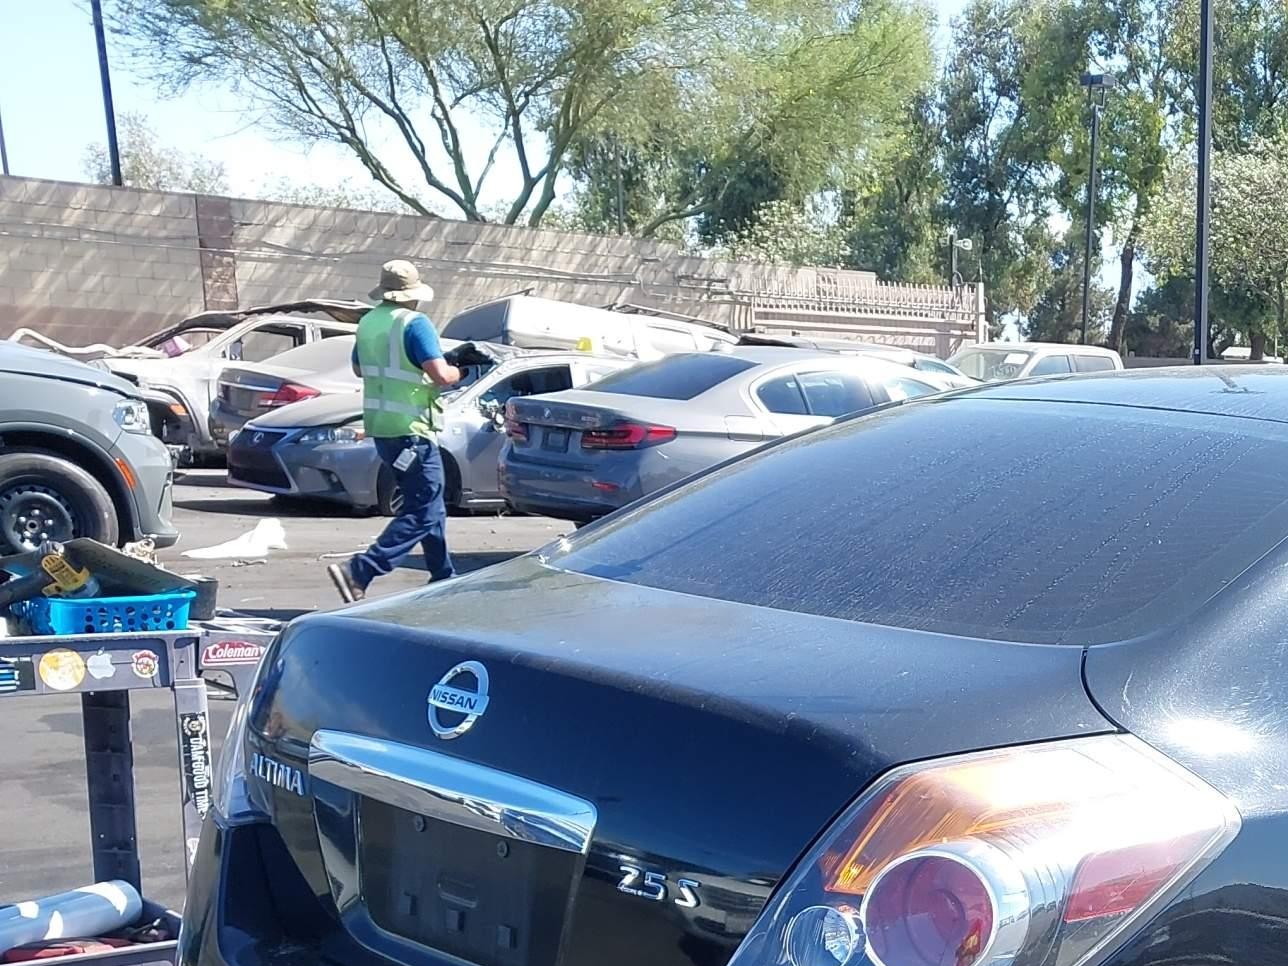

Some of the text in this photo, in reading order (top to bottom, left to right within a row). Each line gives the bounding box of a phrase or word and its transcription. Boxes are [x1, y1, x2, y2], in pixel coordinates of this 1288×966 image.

[208, 643, 259, 659] Coleman
[432, 689, 478, 710] NISSAN
[250, 752, 304, 796] ALTIMA
[675, 878, 702, 908] S
